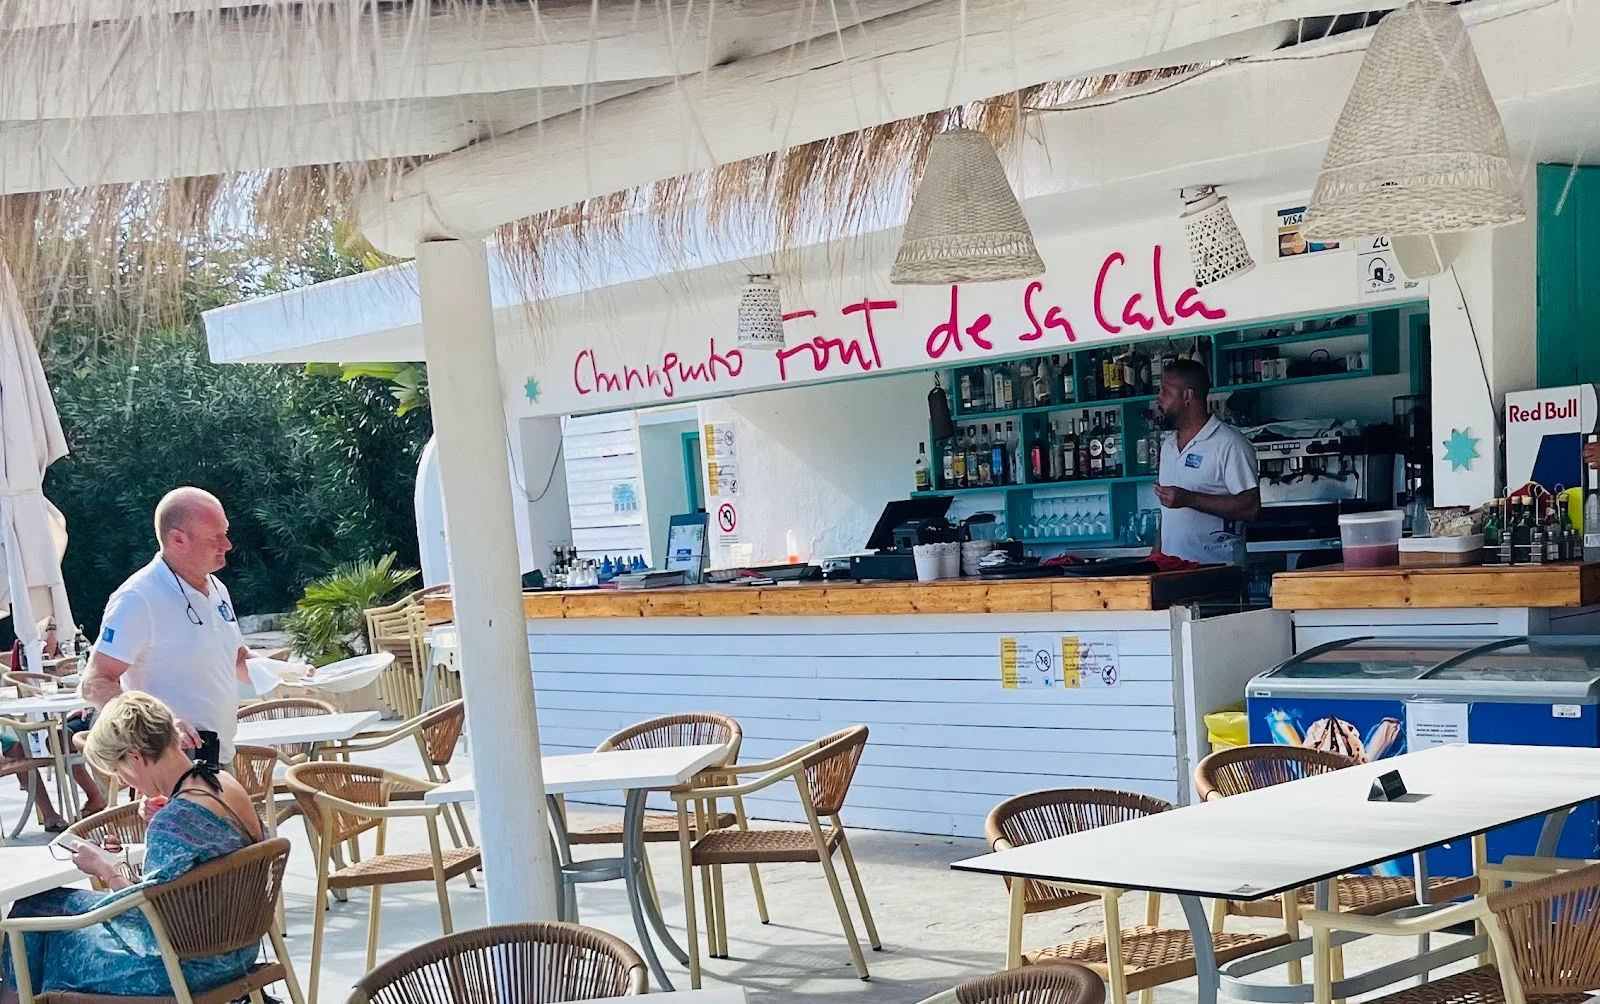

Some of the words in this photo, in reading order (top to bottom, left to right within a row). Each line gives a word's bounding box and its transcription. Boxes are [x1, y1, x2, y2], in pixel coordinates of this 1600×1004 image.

[1283, 214, 1303, 226] VISA
[925, 284, 994, 360] de
[1018, 280, 1077, 343] Sa
[1093, 245, 1228, 335] Cala
[1509, 402, 1541, 423] Red
[1545, 399, 1577, 420] Bull
